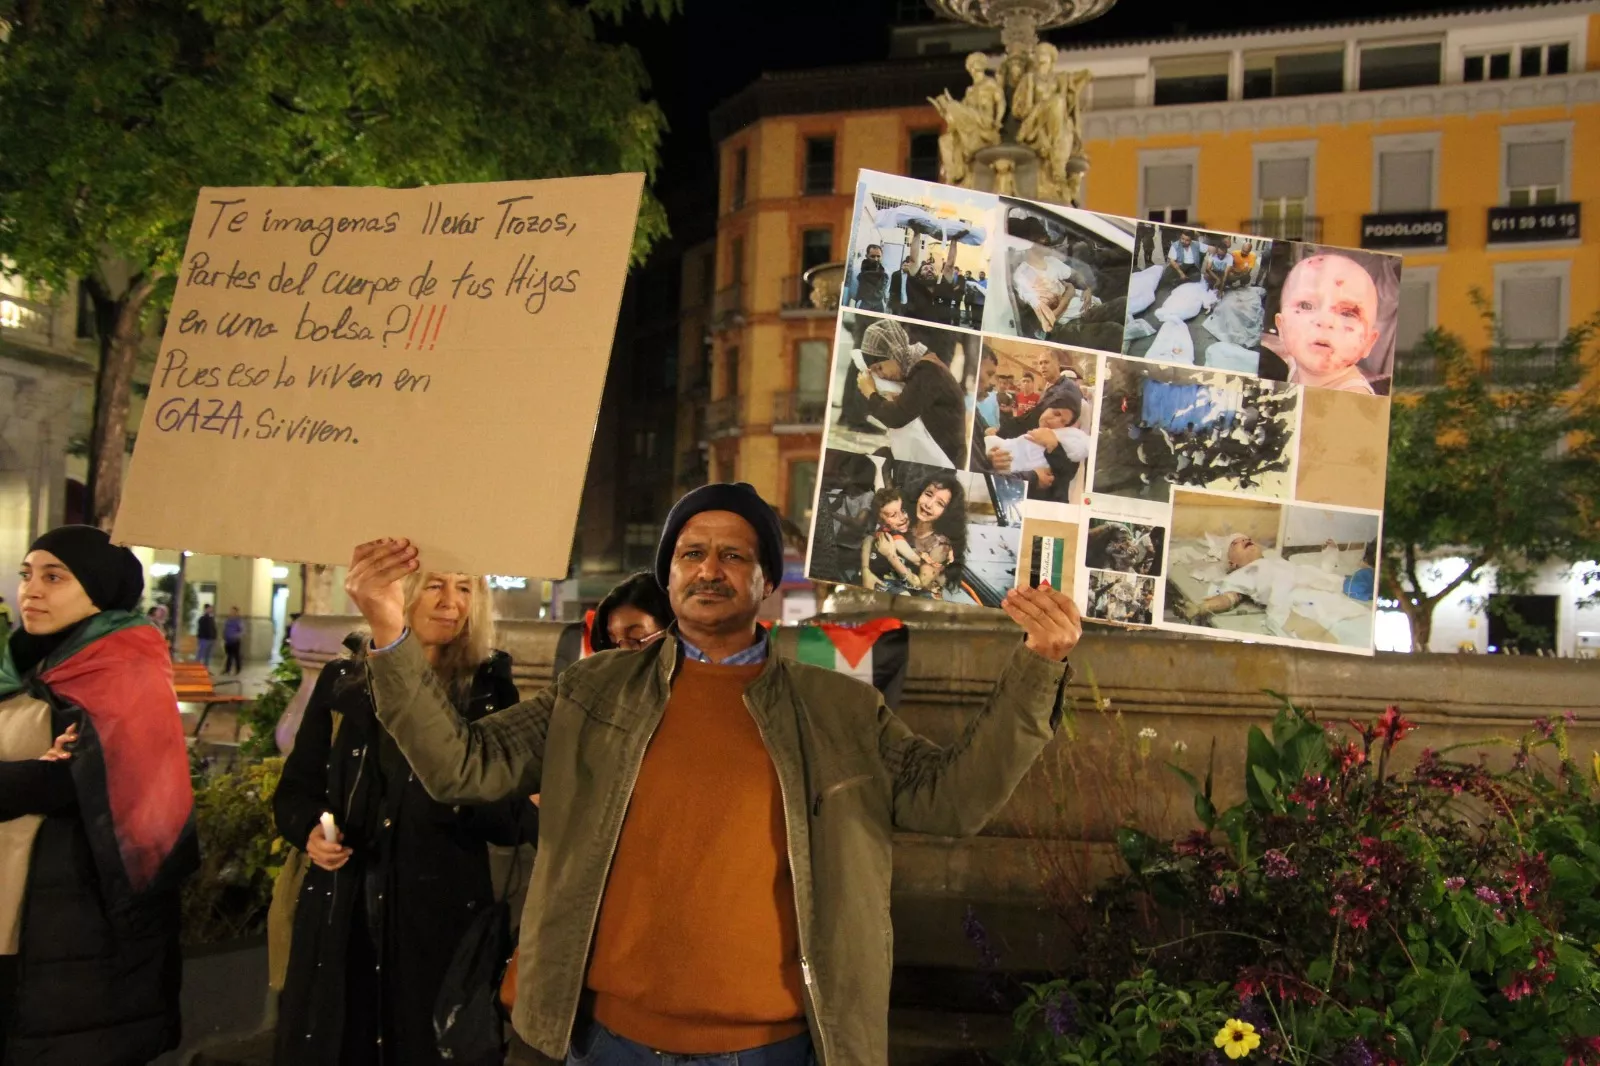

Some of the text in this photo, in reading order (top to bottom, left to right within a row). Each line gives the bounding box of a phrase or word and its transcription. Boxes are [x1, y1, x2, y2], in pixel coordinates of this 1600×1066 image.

[208, 198, 249, 240] Te
[421, 201, 485, 236] llevar
[494, 195, 577, 240] Trozos,
[186, 251, 261, 290] Partes
[268, 260, 318, 296] del
[408, 259, 438, 300] de
[452, 260, 495, 300] tus
[505, 253, 580, 315] Hijos
[178, 309, 208, 335] en
[216, 311, 279, 339] una
[160, 348, 222, 389] Pues
[227, 362, 270, 388] eso
[394, 367, 431, 392] en
